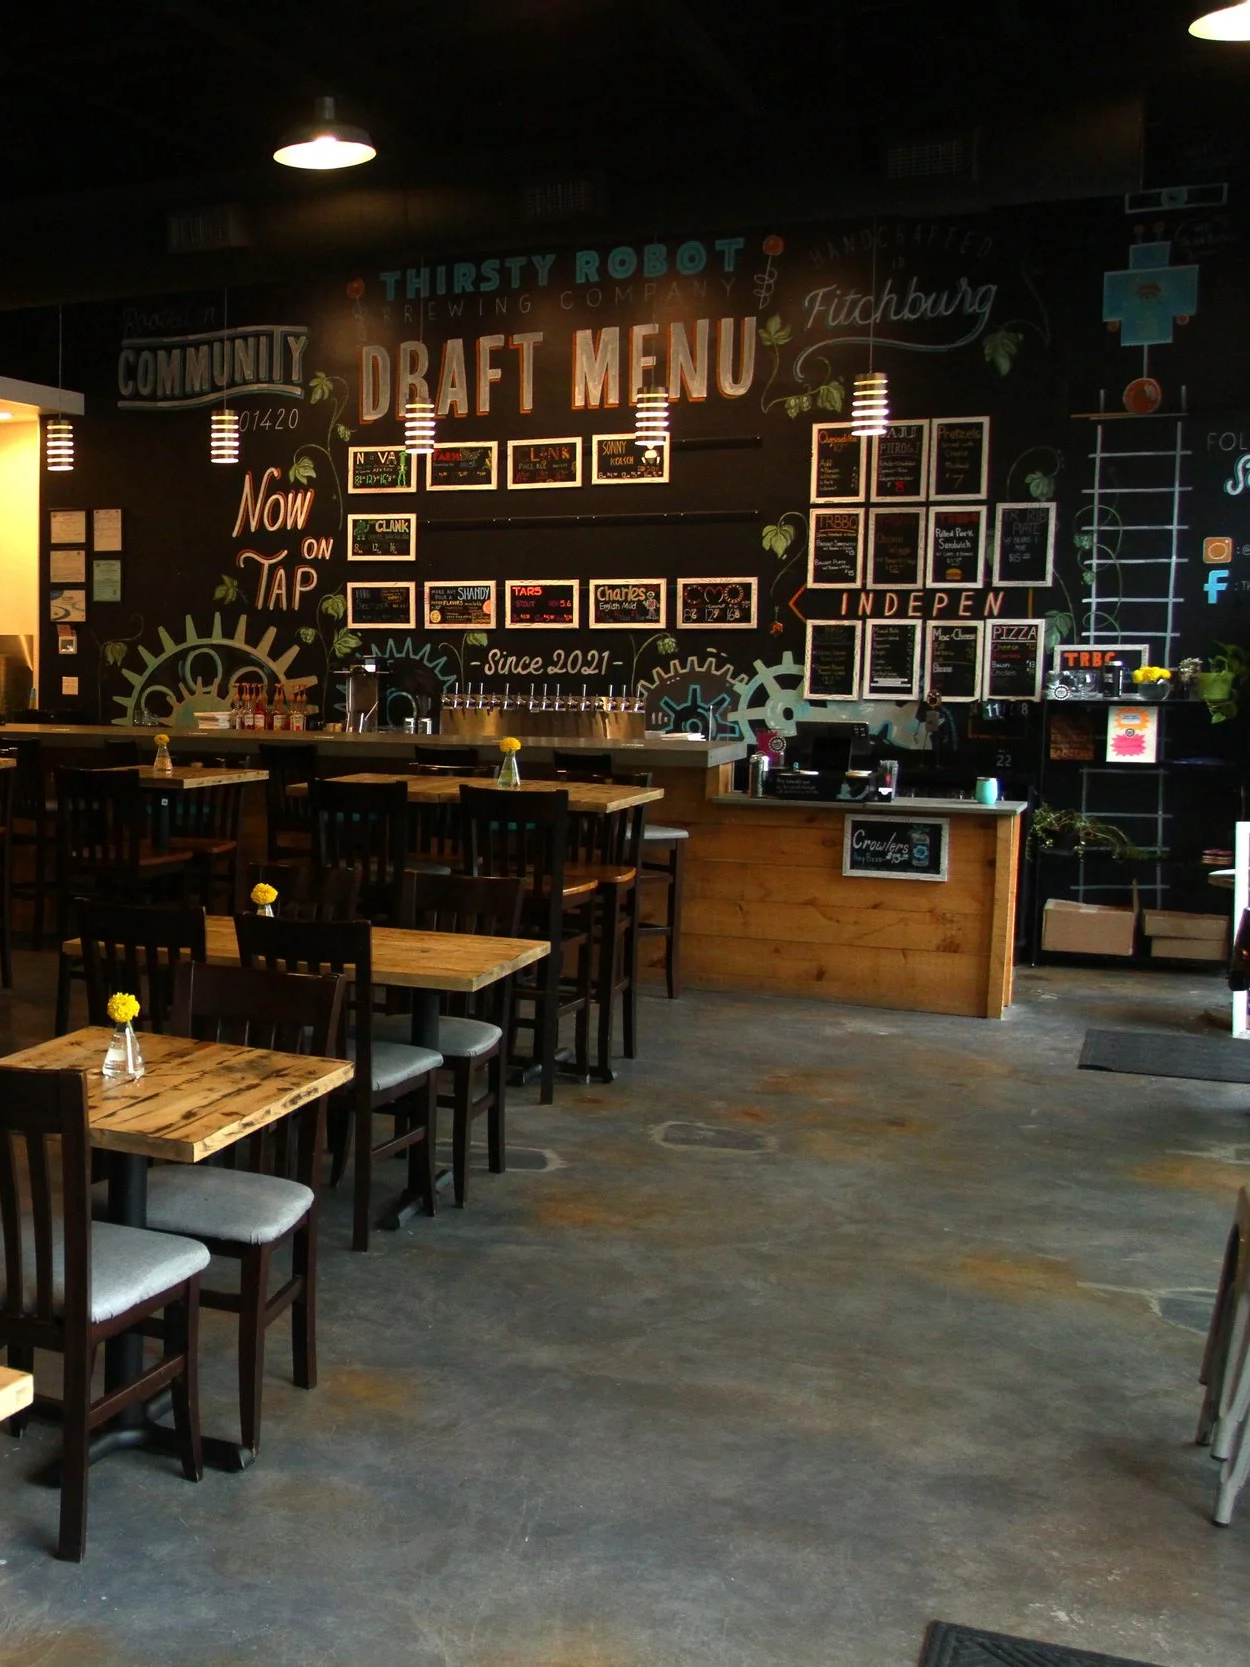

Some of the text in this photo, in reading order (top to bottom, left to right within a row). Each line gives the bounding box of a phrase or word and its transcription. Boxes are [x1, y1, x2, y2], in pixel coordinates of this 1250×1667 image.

[379, 237, 746, 302] THIRSTY ROBOT
[560, 276, 738, 310] COMPANY
[117, 326, 307, 400] COMMUNITY
[359, 315, 758, 425] DRAFT MENU
[239, 407, 300, 432] 01420
[231, 466, 315, 538] Now
[375, 520, 410, 533] CLANK
[300, 536, 334, 560] ON
[939, 539, 971, 550] Sandwich
[235, 549, 318, 611] TAP
[512, 587, 542, 596] TARS
[457, 587, 489, 600] SHANDY
[597, 586, 646, 601] Charles
[599, 602, 620, 611] English
[993, 627, 1037, 640] PIZZA
[484, 648, 544, 676] Since
[546, 648, 610, 675] 2021
[852, 829, 909, 853] Crowlers
